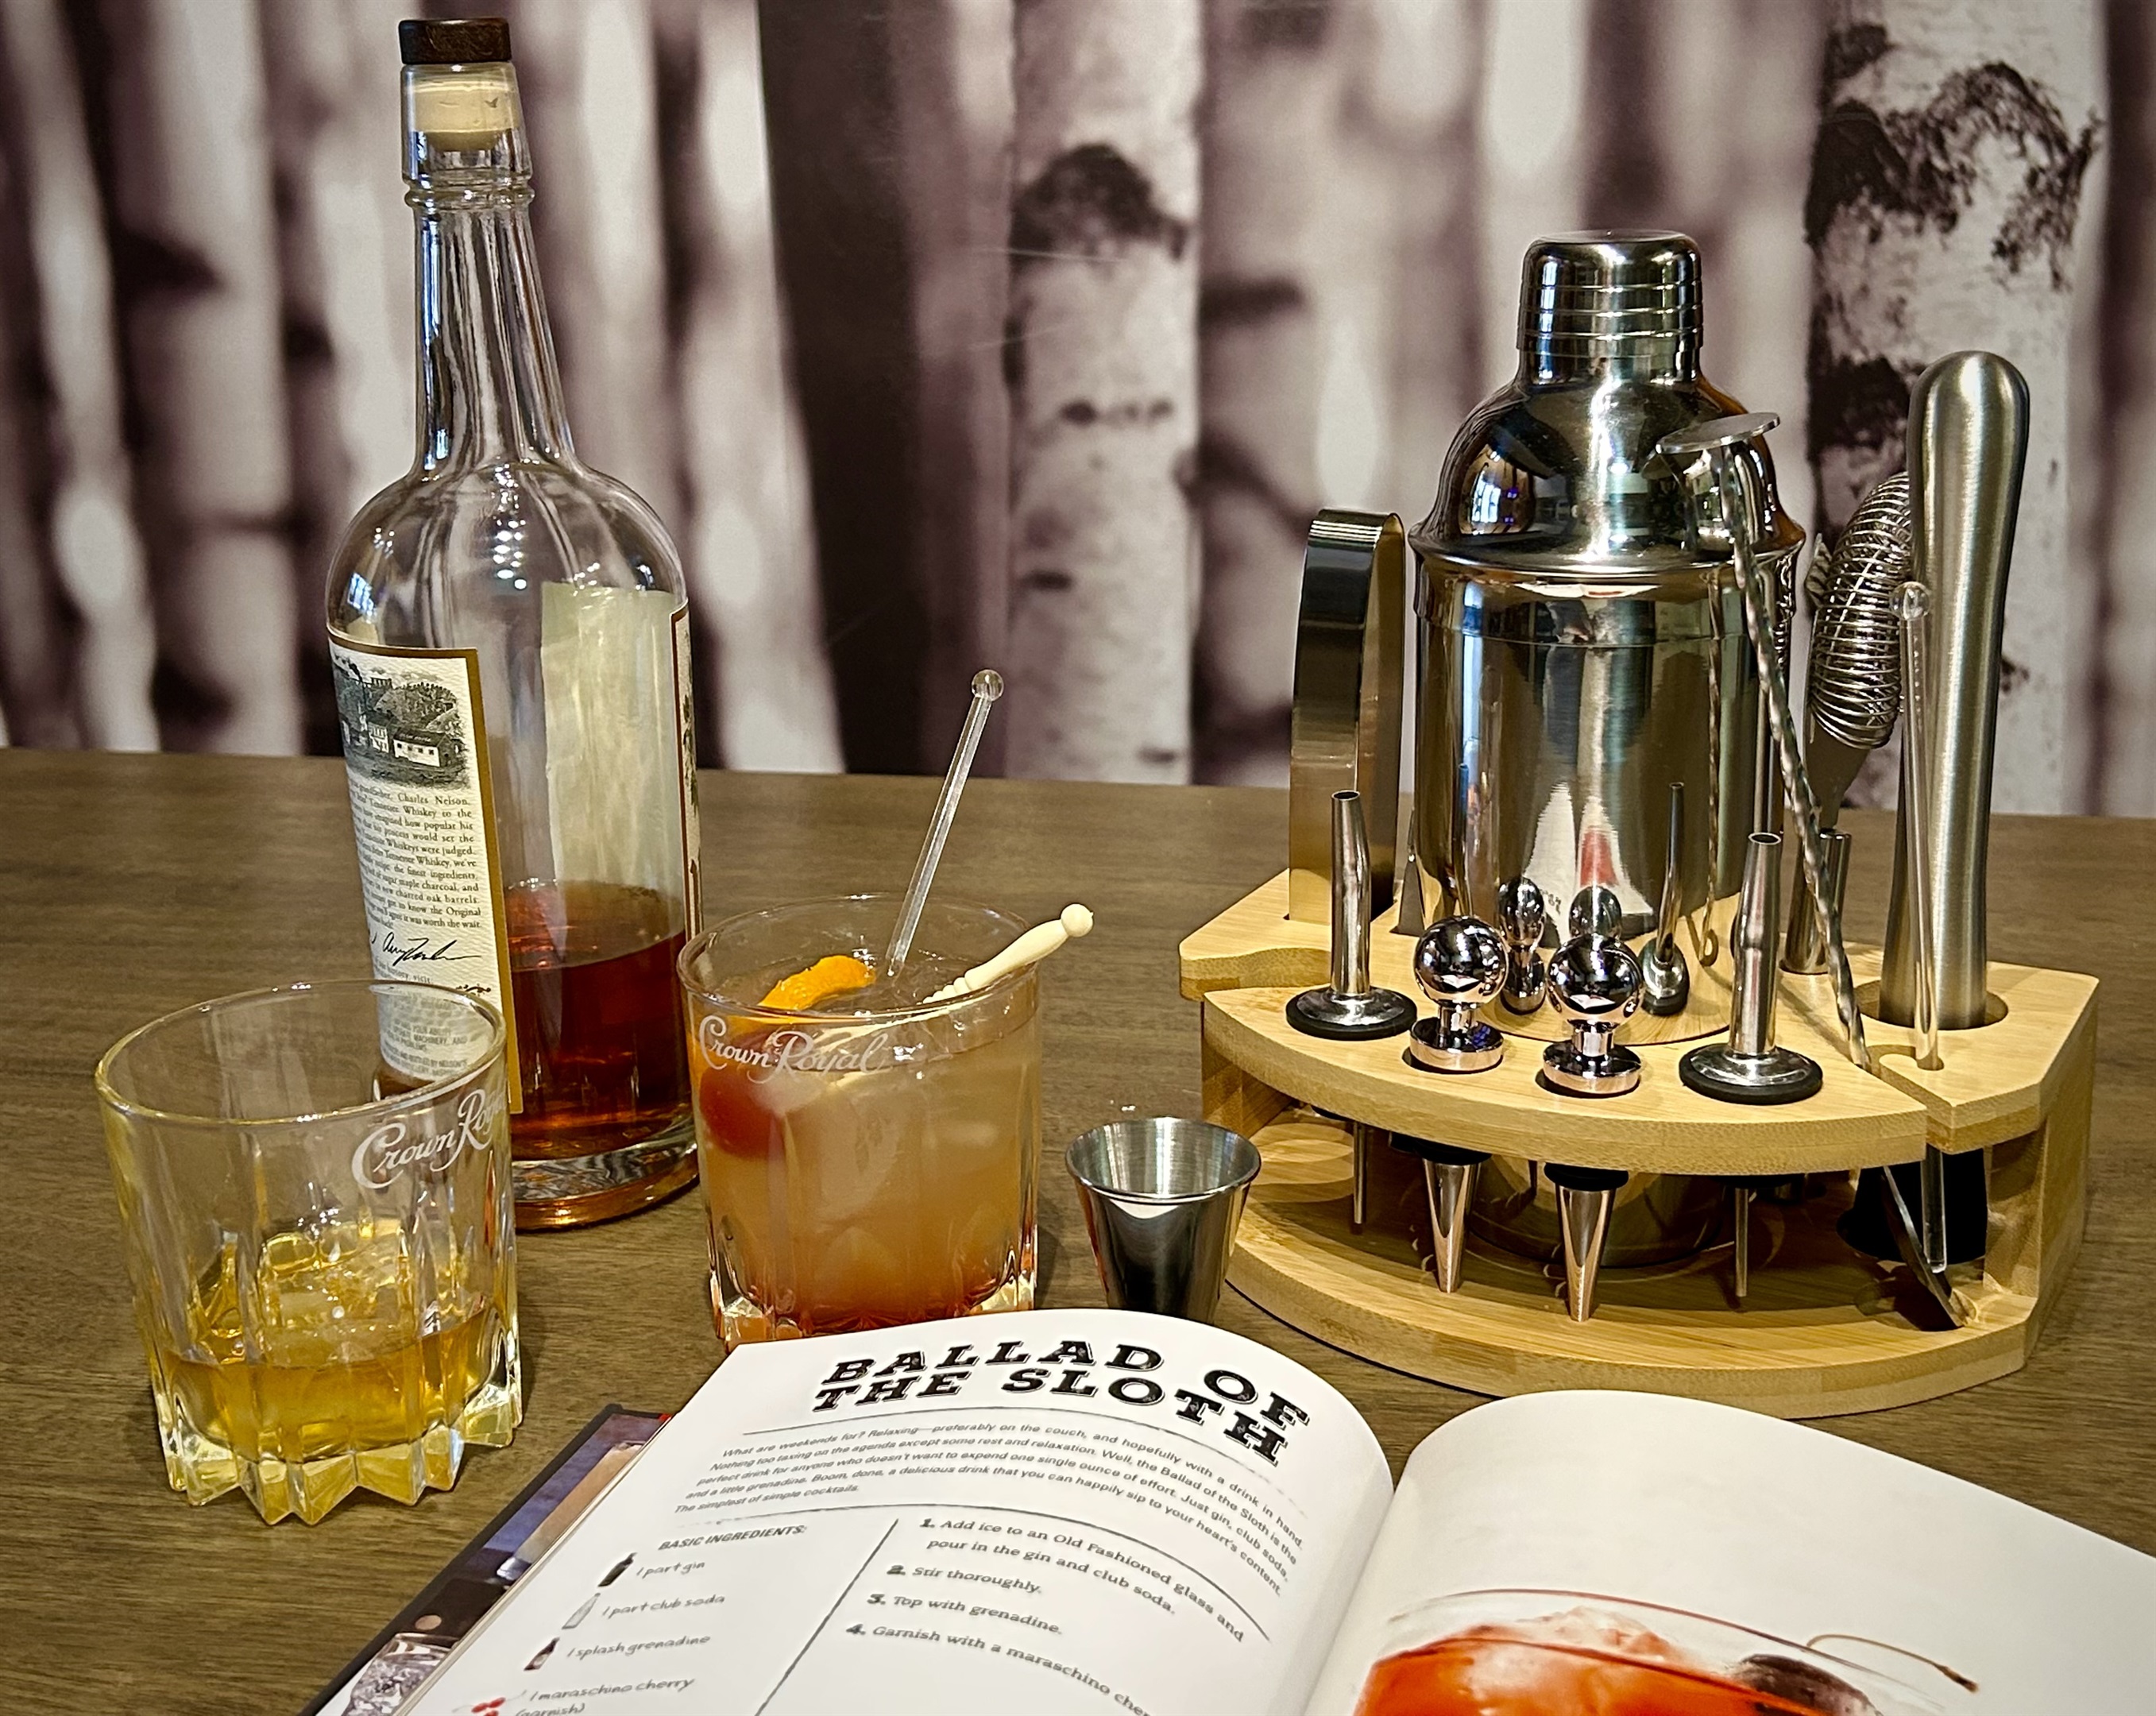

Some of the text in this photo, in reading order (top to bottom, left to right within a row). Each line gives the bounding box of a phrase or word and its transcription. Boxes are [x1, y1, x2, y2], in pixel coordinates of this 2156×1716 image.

[458, 808, 472, 817] the
[460, 821, 473, 830] his
[459, 833, 474, 843] the
[462, 883, 479, 891] and
[699, 1015, 894, 1084] Crown Royal
[352, 1123, 457, 1189] Crown
[821, 1340, 1310, 1427] BALLAD OF
[812, 1367, 1288, 1467] THE SLOTH
[723, 1447, 753, 1457] What
[756, 1445, 775, 1454] are
[779, 1436, 837, 1449] weekends
[841, 1431, 866, 1441] for?
[1021, 1424, 1041, 1432] the
[1045, 1427, 1087, 1439] couch,
[1093, 1433, 1119, 1444] and
[1122, 1439, 1181, 1464] hopefully
[1186, 1461, 1213, 1478] with
[1229, 1482, 1259, 1507] drink
[1262, 1505, 1273, 1518] in
[674, 1504, 696, 1513] The
[697, 1497, 747, 1510] simplest
[748, 1494, 762, 1503] of
[762, 1490, 802, 1502] simple
[686, 1489, 710, 1499] and
[720, 1485, 745, 1494] little
[993, 1467, 1018, 1476] that
[1020, 1470, 1045, 1478] you
[1048, 1473, 1073, 1483] can
[1075, 1477, 1125, 1496] happily
[1126, 1490, 1146, 1503] sip
[1149, 1498, 1162, 1509] to
[1165, 1505, 1194, 1524] your
[696, 1474, 740, 1486] perfect
[741, 1468, 771, 1479] drink
[790, 1461, 835, 1472] anyone
[837, 1457, 862, 1466] who
[1037, 1455, 1076, 1467] single
[1080, 1462, 1120, 1477] ounce
[1123, 1473, 1138, 1482] of
[1181, 1494, 1209, 1513] Just
[1211, 1511, 1232, 1529] gin,
[1236, 1526, 1261, 1550] club
[709, 1459, 755, 1471] Nothing
[756, 1456, 775, 1465] too
[777, 1451, 813, 1462] taxing
[831, 1446, 850, 1455] the
[851, 1441, 896, 1452] agenda
[898, 1439, 940, 1447] except
[1137, 1459, 1157, 1471] the
[1161, 1467, 1202, 1490] Ballad
[1204, 1486, 1218, 1498] of
[1218, 1494, 1238, 1511] the
[1241, 1508, 1269, 1536] Sloth
[1270, 1532, 1280, 1546] is
[1281, 1544, 1296, 1565] the
[658, 1536, 704, 1550] BASIC
[642, 1562, 682, 1579] part
[681, 1562, 705, 1575] gin
[887, 1564, 1041, 1594] 2. Stir thoroughly.
[919, 1518, 935, 1528] 1.
[940, 1521, 975, 1529] Add
[979, 1522, 1002, 1532] ice
[1027, 1530, 1048, 1540] an
[1053, 1534, 1083, 1548] Old
[1088, 1543, 1171, 1585] Fashioned
[1173, 1583, 1214, 1614] glass
[1217, 1614, 1244, 1642] and
[926, 1540, 1175, 1615] pour in the gin and club soda.
[608, 1602, 649, 1619] part
[651, 1598, 681, 1610] club
[685, 1594, 725, 1606] soda
[867, 1594, 1062, 1635] 3. Top with grenadine.
[575, 1642, 624, 1660] splash
[625, 1636, 710, 1656] grenadine
[846, 1624, 866, 1635] 4.
[872, 1626, 941, 1641] Garnish
[947, 1634, 985, 1649] with
[1007, 1647, 1111, 1695] maraschino
[539, 1684, 632, 1700] maraschino
[636, 1677, 694, 1692] cherry
[516, 1702, 585, 1716] (garnish)
